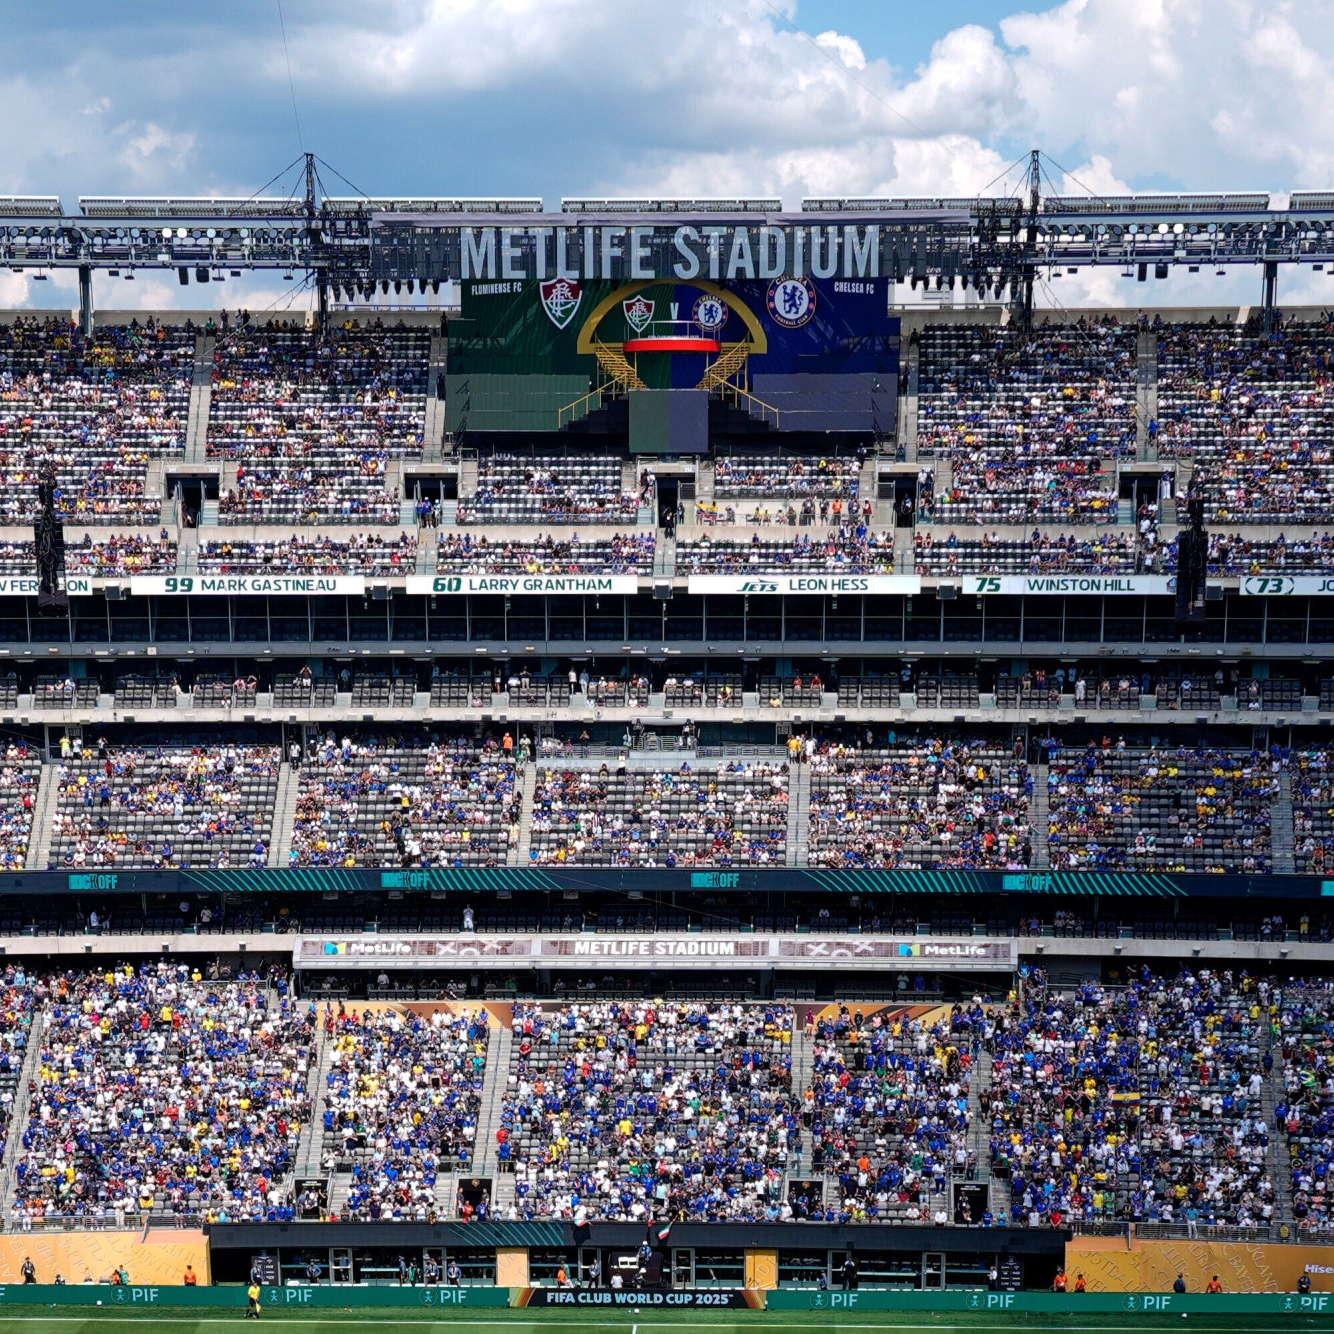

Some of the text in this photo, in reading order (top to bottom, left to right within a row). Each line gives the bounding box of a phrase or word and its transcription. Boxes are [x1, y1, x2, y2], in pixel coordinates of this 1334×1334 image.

[460, 225, 879, 280] METLIFE STADIUM
[513, 281, 522, 293] FC
[834, 281, 875, 295] CHELSEA FC
[670, 302, 680, 320] V
[10, 579, 89, 593] FERON
[164, 577, 337, 593] 99 MARK GASTINEAU
[432, 577, 612, 593] 60 LARRY GRANTHAM
[736, 578, 869, 592] JETS LEON HESS
[975, 577, 1135, 593] 75 WINSTON HILL
[1256, 578, 1284, 594] 73
[410, 871, 430, 888] OFF
[1032, 874, 1052, 891] OFF
[350, 942, 411, 955] MetLife
[574, 941, 735, 955] METLIFE STADIUM
[924, 945, 986, 957] MetLife
[132, 1288, 159, 1302] PIF
[286, 1288, 313, 1303] PIF
[440, 1289, 467, 1304] PIF
[546, 1292, 575, 1304] FIFA
[578, 1292, 614, 1304] CLUB
[615, 1292, 664, 1305] WORLD
[665, 1293, 693, 1305] CUP
[831, 1293, 859, 1307] PIF
[987, 1294, 1015, 1308] PIF
[1143, 1295, 1172, 1310] PIF
[1301, 1296, 1329, 1311] PIF
